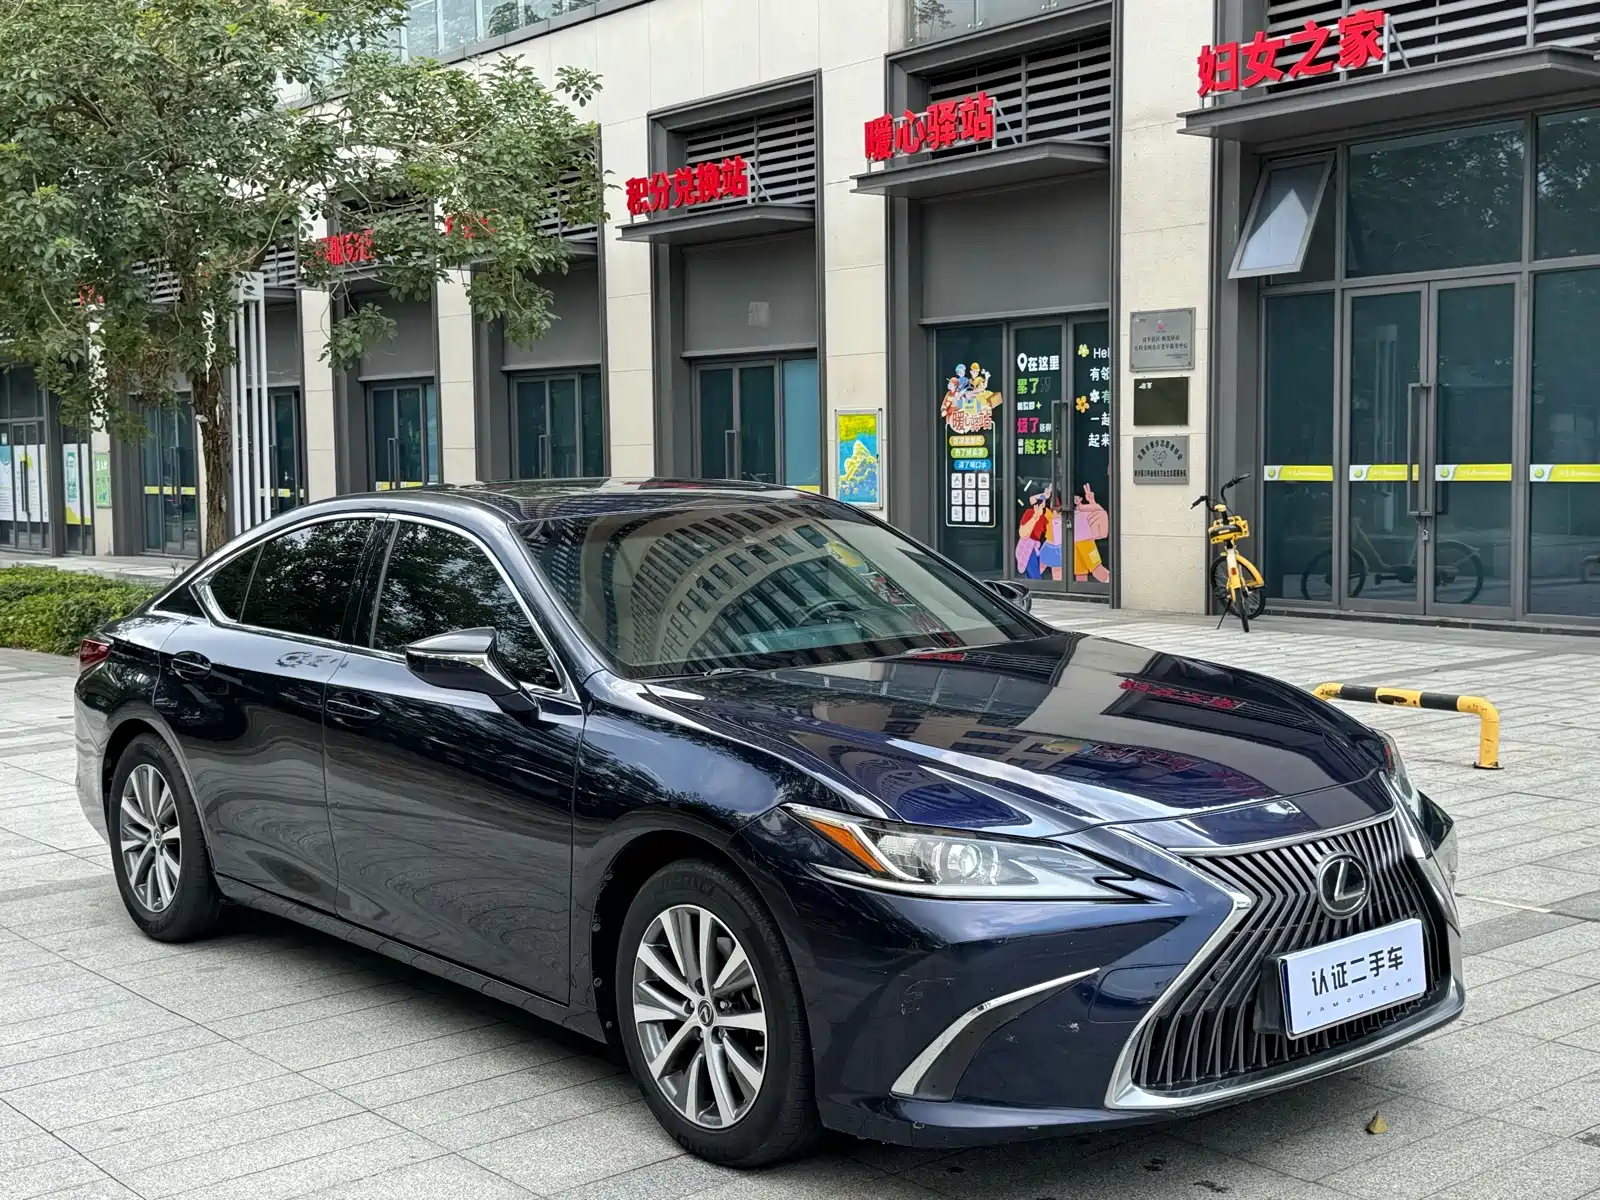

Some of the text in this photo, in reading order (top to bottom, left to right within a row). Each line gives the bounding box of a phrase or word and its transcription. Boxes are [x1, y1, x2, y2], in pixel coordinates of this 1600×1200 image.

[1197, 9, 1385, 97] 妇女之家
[864, 90, 993, 161] 暖心驿站
[625, 155, 748, 216] 积分兑换站
[1028, 355, 1060, 372] 在这里
[952, 409, 992, 431] 暖心驿站
[1311, 946, 1404, 997] 认证二手车
